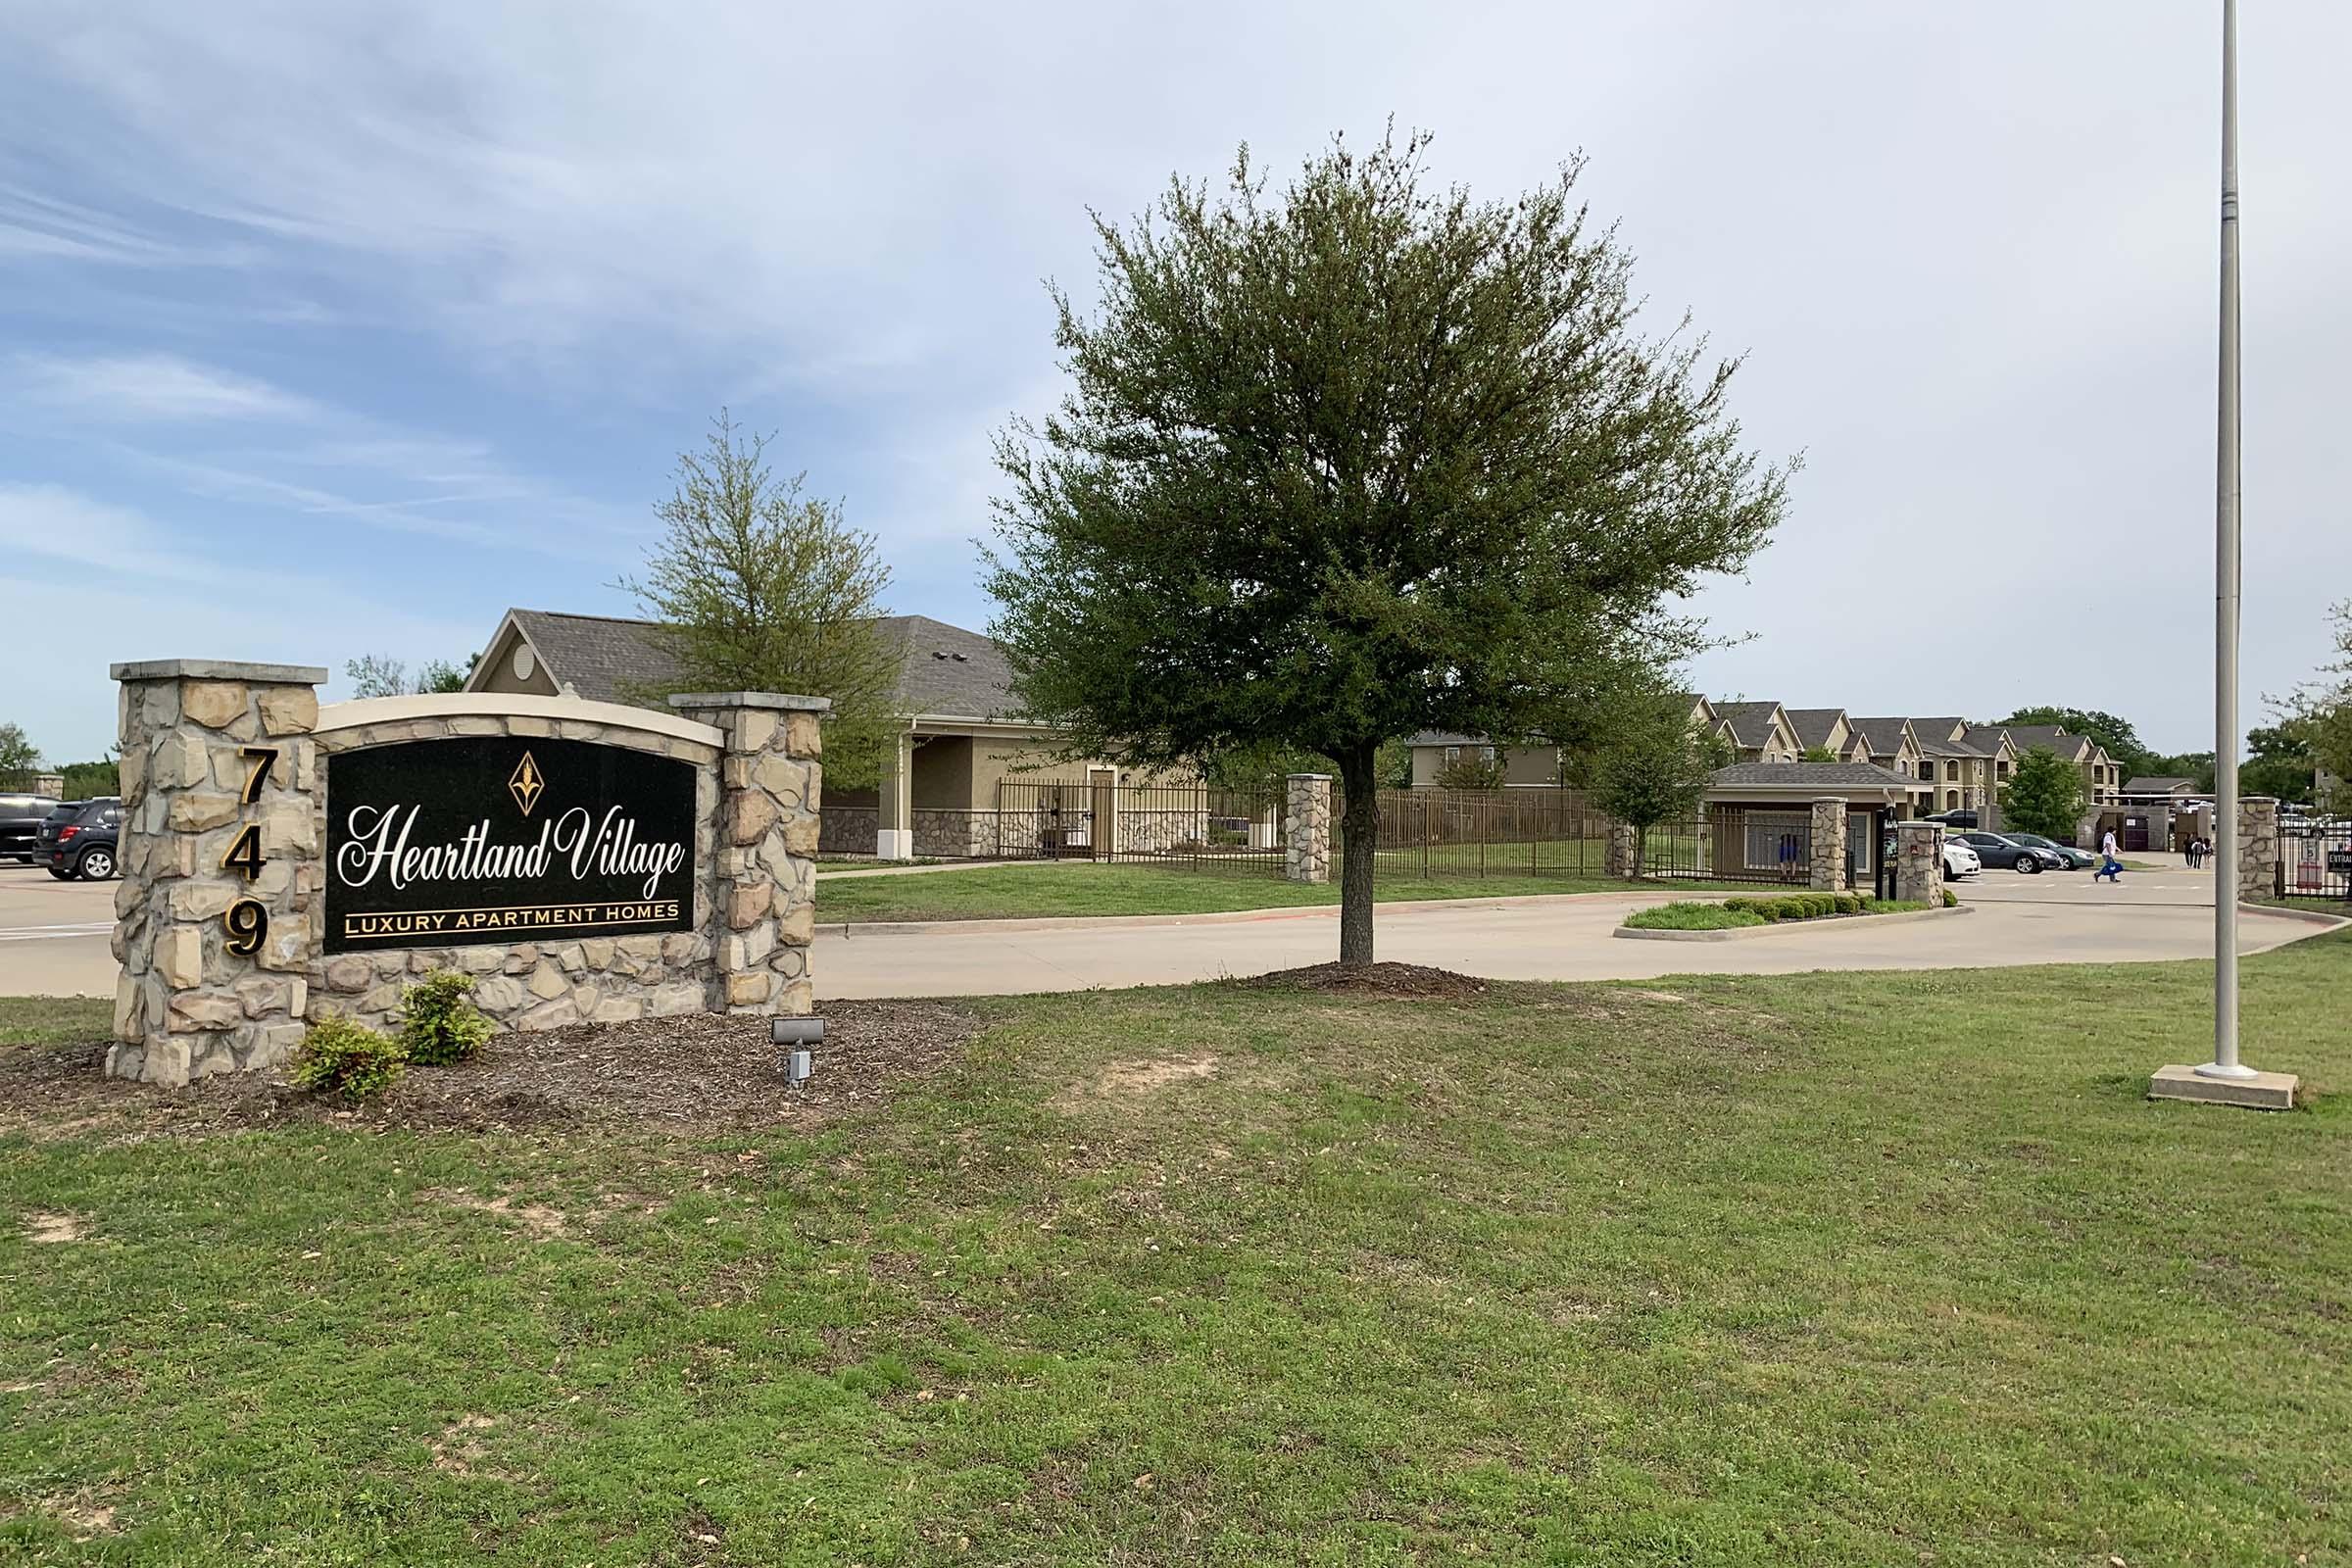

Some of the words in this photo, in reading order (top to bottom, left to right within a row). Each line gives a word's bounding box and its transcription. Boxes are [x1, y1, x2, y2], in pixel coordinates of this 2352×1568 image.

[337, 804, 552, 891] Heartland
[554, 804, 686, 901] Village
[345, 914, 446, 934] LUXURY
[456, 907, 597, 928] APARTMENT
[606, 904, 679, 920] HOMES
